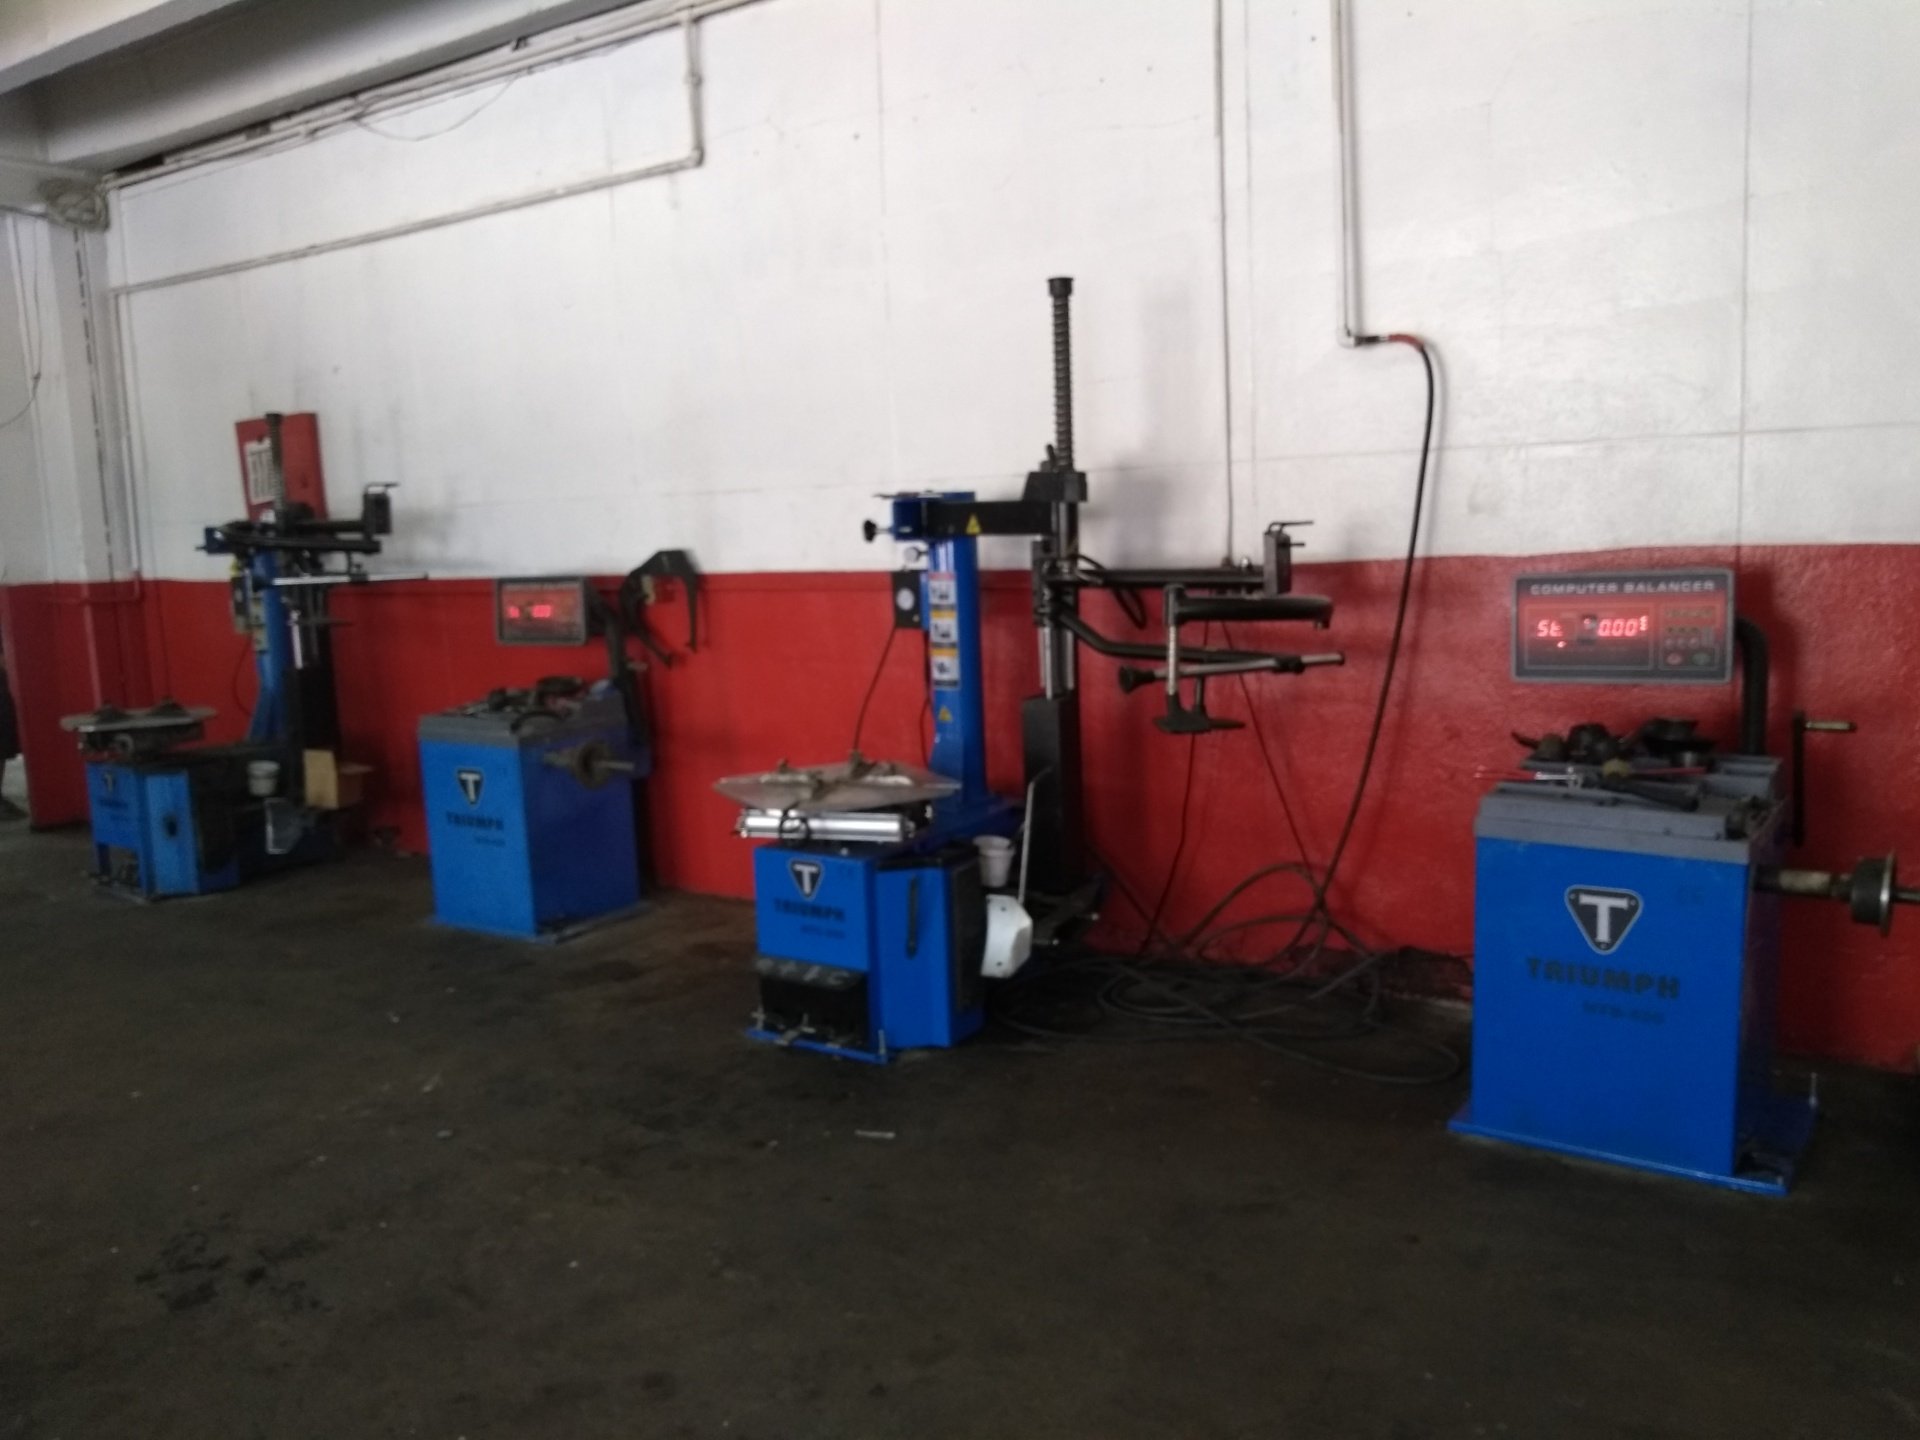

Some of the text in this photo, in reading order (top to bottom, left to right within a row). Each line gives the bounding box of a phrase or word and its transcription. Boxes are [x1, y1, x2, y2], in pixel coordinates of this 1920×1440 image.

[1530, 579, 1715, 595] COMPUTER BALANCER
[460, 772, 481, 802] T
[793, 863, 819, 895] T
[1578, 893, 1629, 943] T
[1526, 957, 1681, 1000] TRIUMPH
